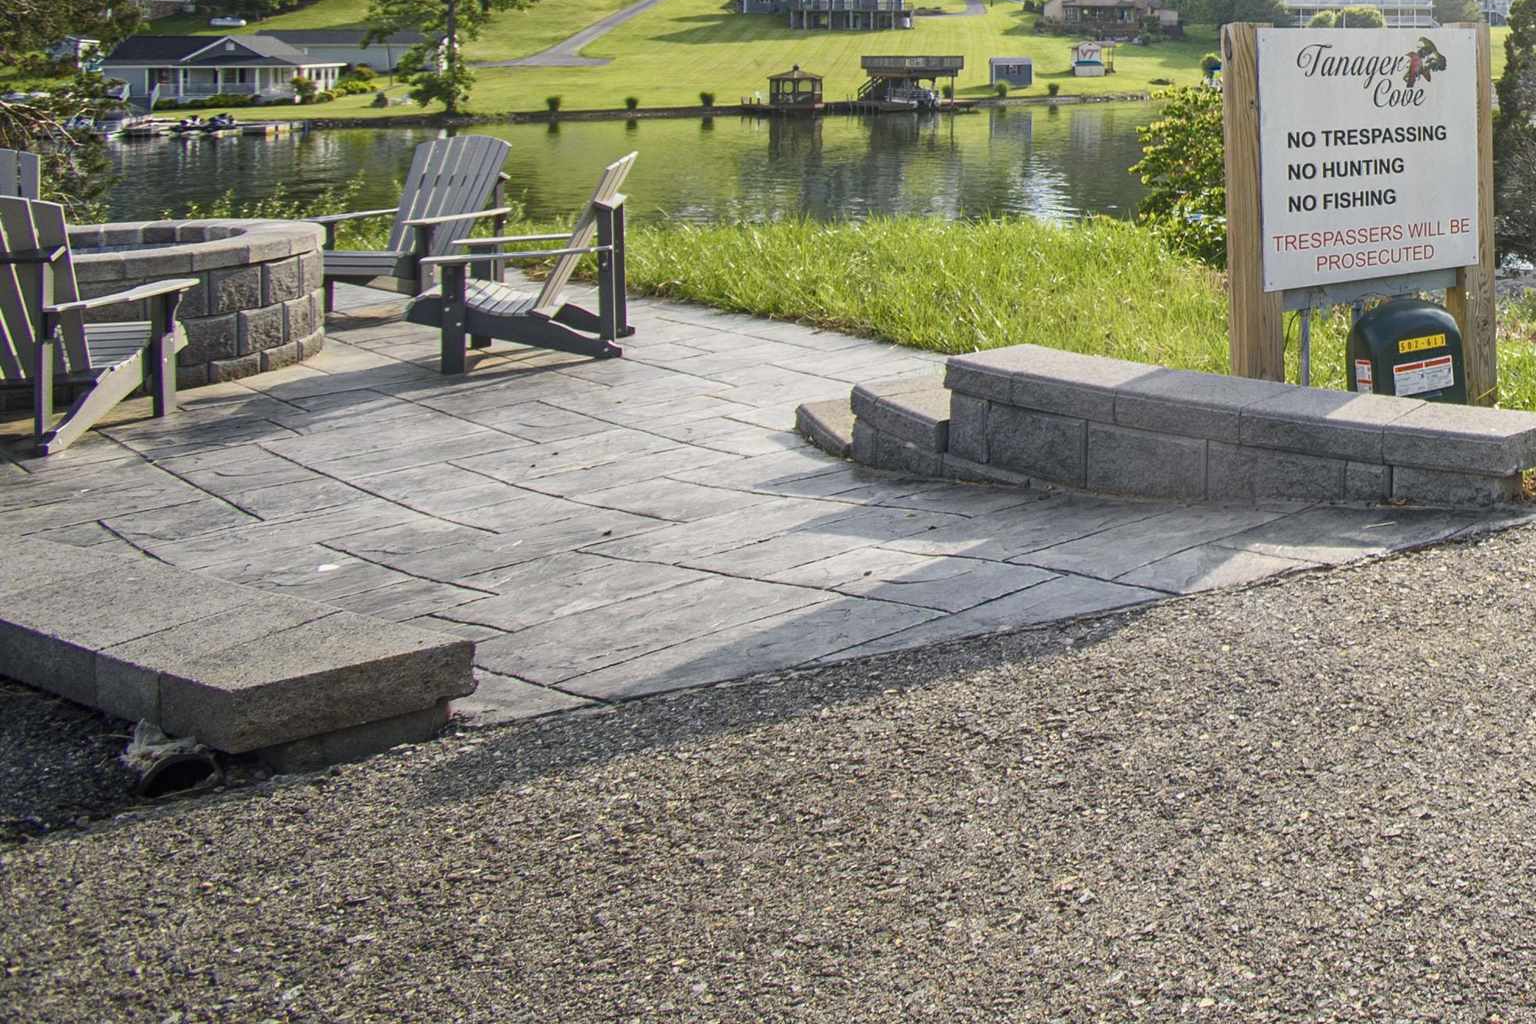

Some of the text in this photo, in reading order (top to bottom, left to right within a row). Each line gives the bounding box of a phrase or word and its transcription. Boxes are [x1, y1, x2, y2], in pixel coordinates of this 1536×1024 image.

[1296, 43, 1405, 89] Tanager
[1372, 78, 1426, 108] Cove
[1286, 125, 1448, 149] NO TRESPASSING
[1287, 157, 1405, 181] NO HUNTING
[1287, 188, 1397, 213] NO FISHING
[1272, 218, 1471, 253] TRESPASSERS WILL BE
[1316, 244, 1435, 272] PROSECUTED
